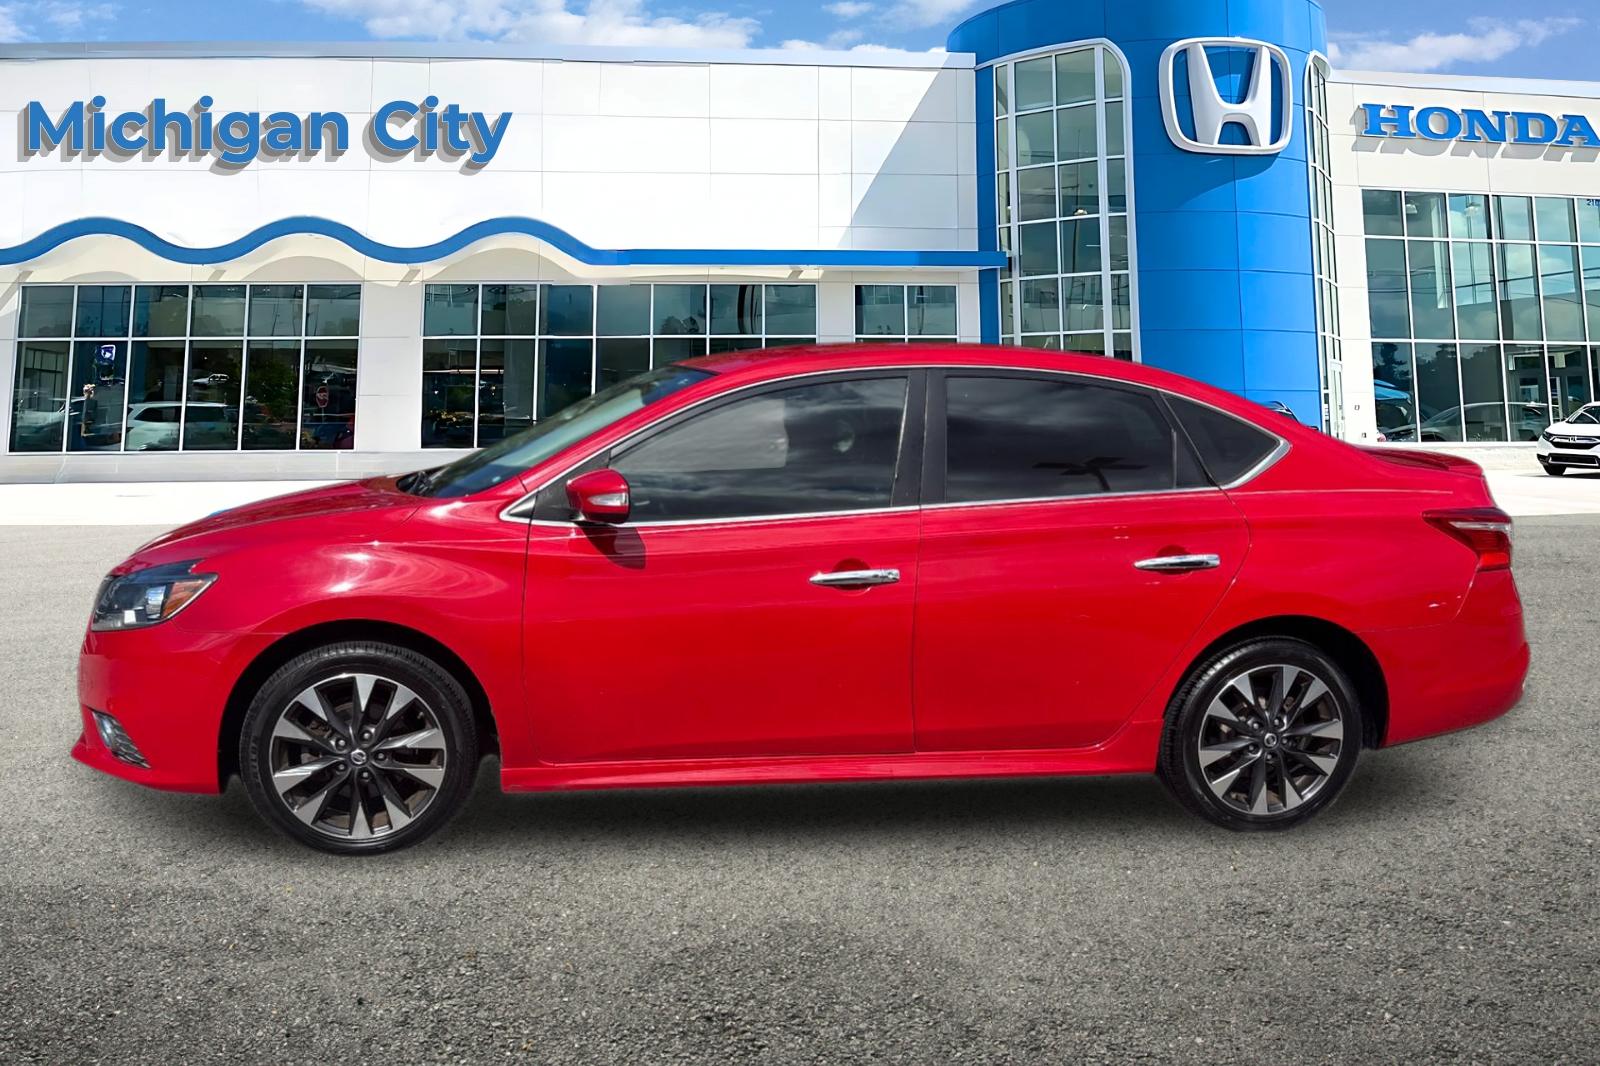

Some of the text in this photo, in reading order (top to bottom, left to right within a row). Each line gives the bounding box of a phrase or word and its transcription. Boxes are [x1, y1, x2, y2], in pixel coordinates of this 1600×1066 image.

[27, 95, 513, 164] Michigan City
[1361, 102, 1600, 148] HONDA
